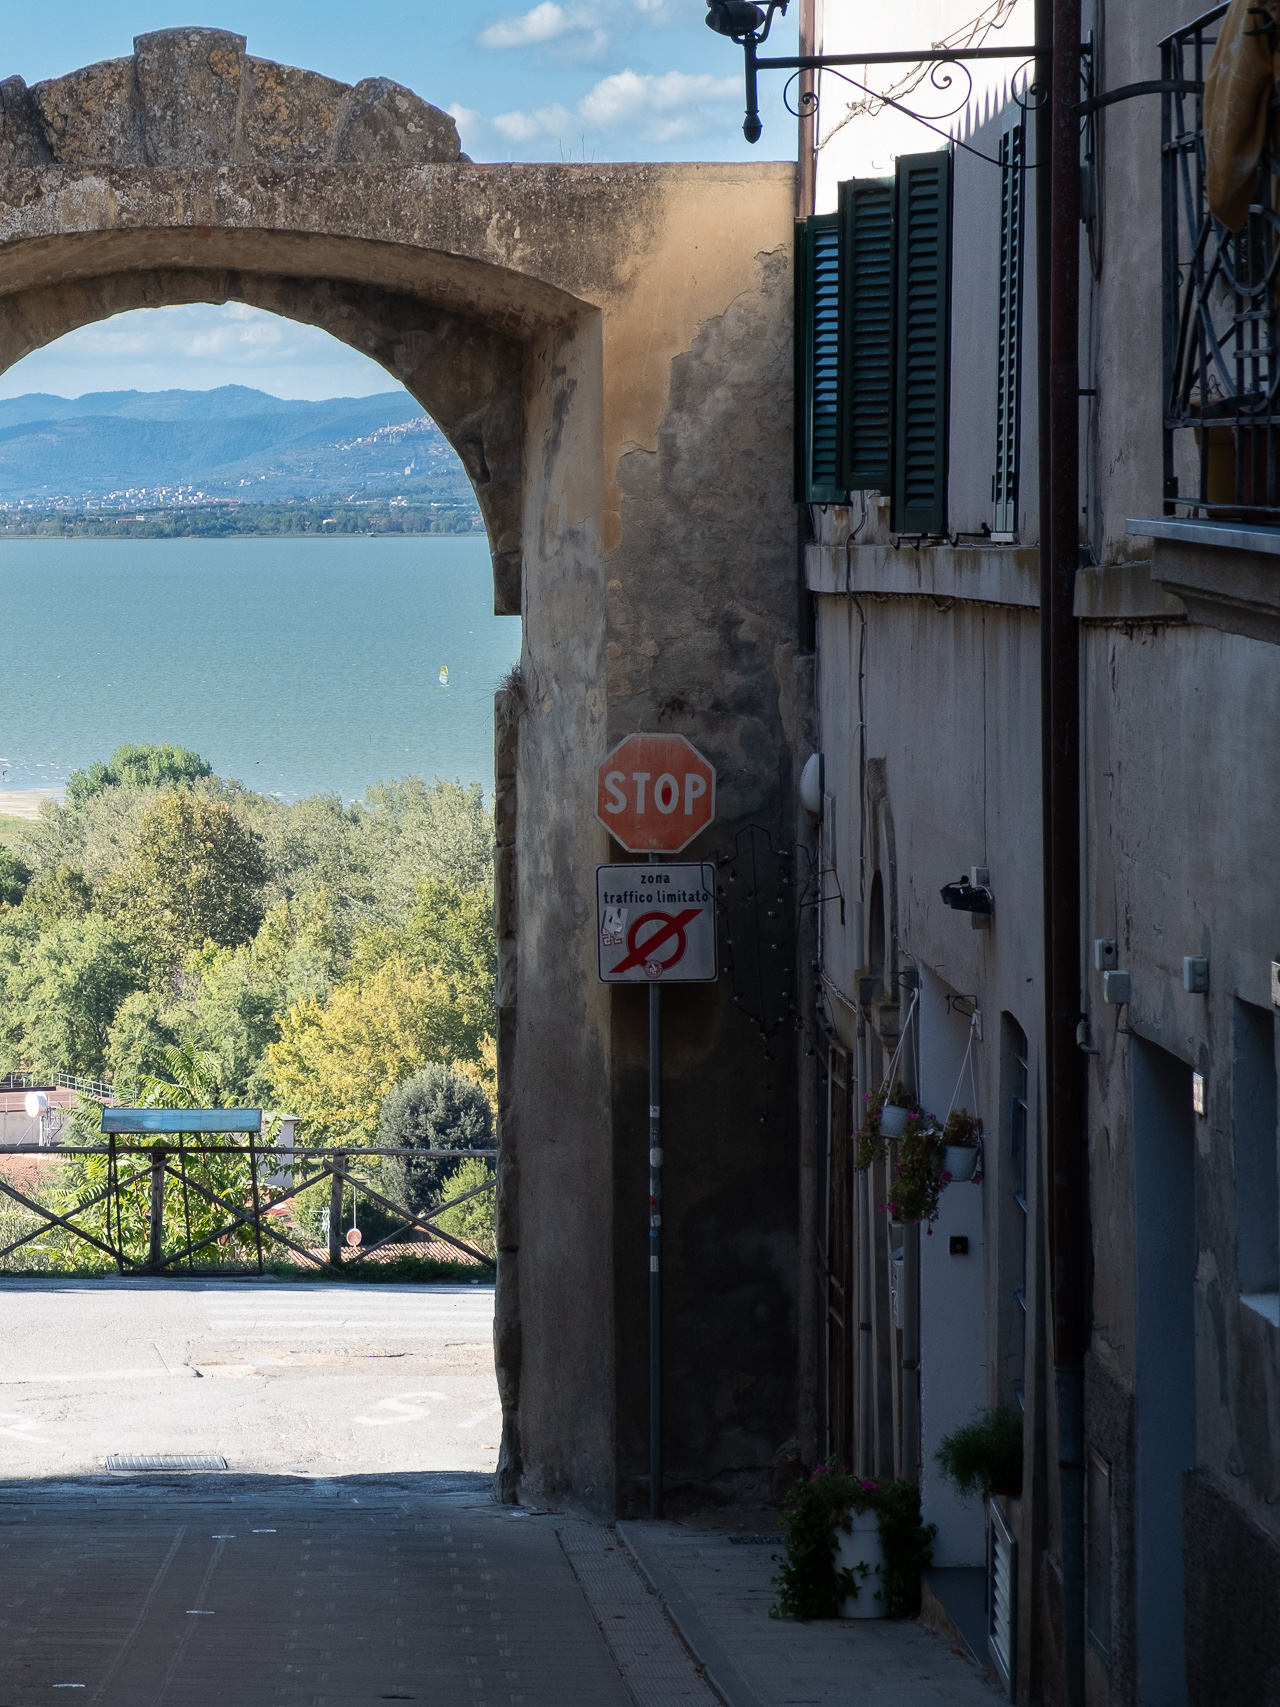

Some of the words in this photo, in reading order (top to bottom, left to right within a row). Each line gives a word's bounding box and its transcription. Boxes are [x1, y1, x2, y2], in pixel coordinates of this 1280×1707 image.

[604, 771, 707, 815] STOP
[640, 874, 670, 884] zona
[603, 891, 653, 904] traffico
[657, 890, 709, 903] limitato
